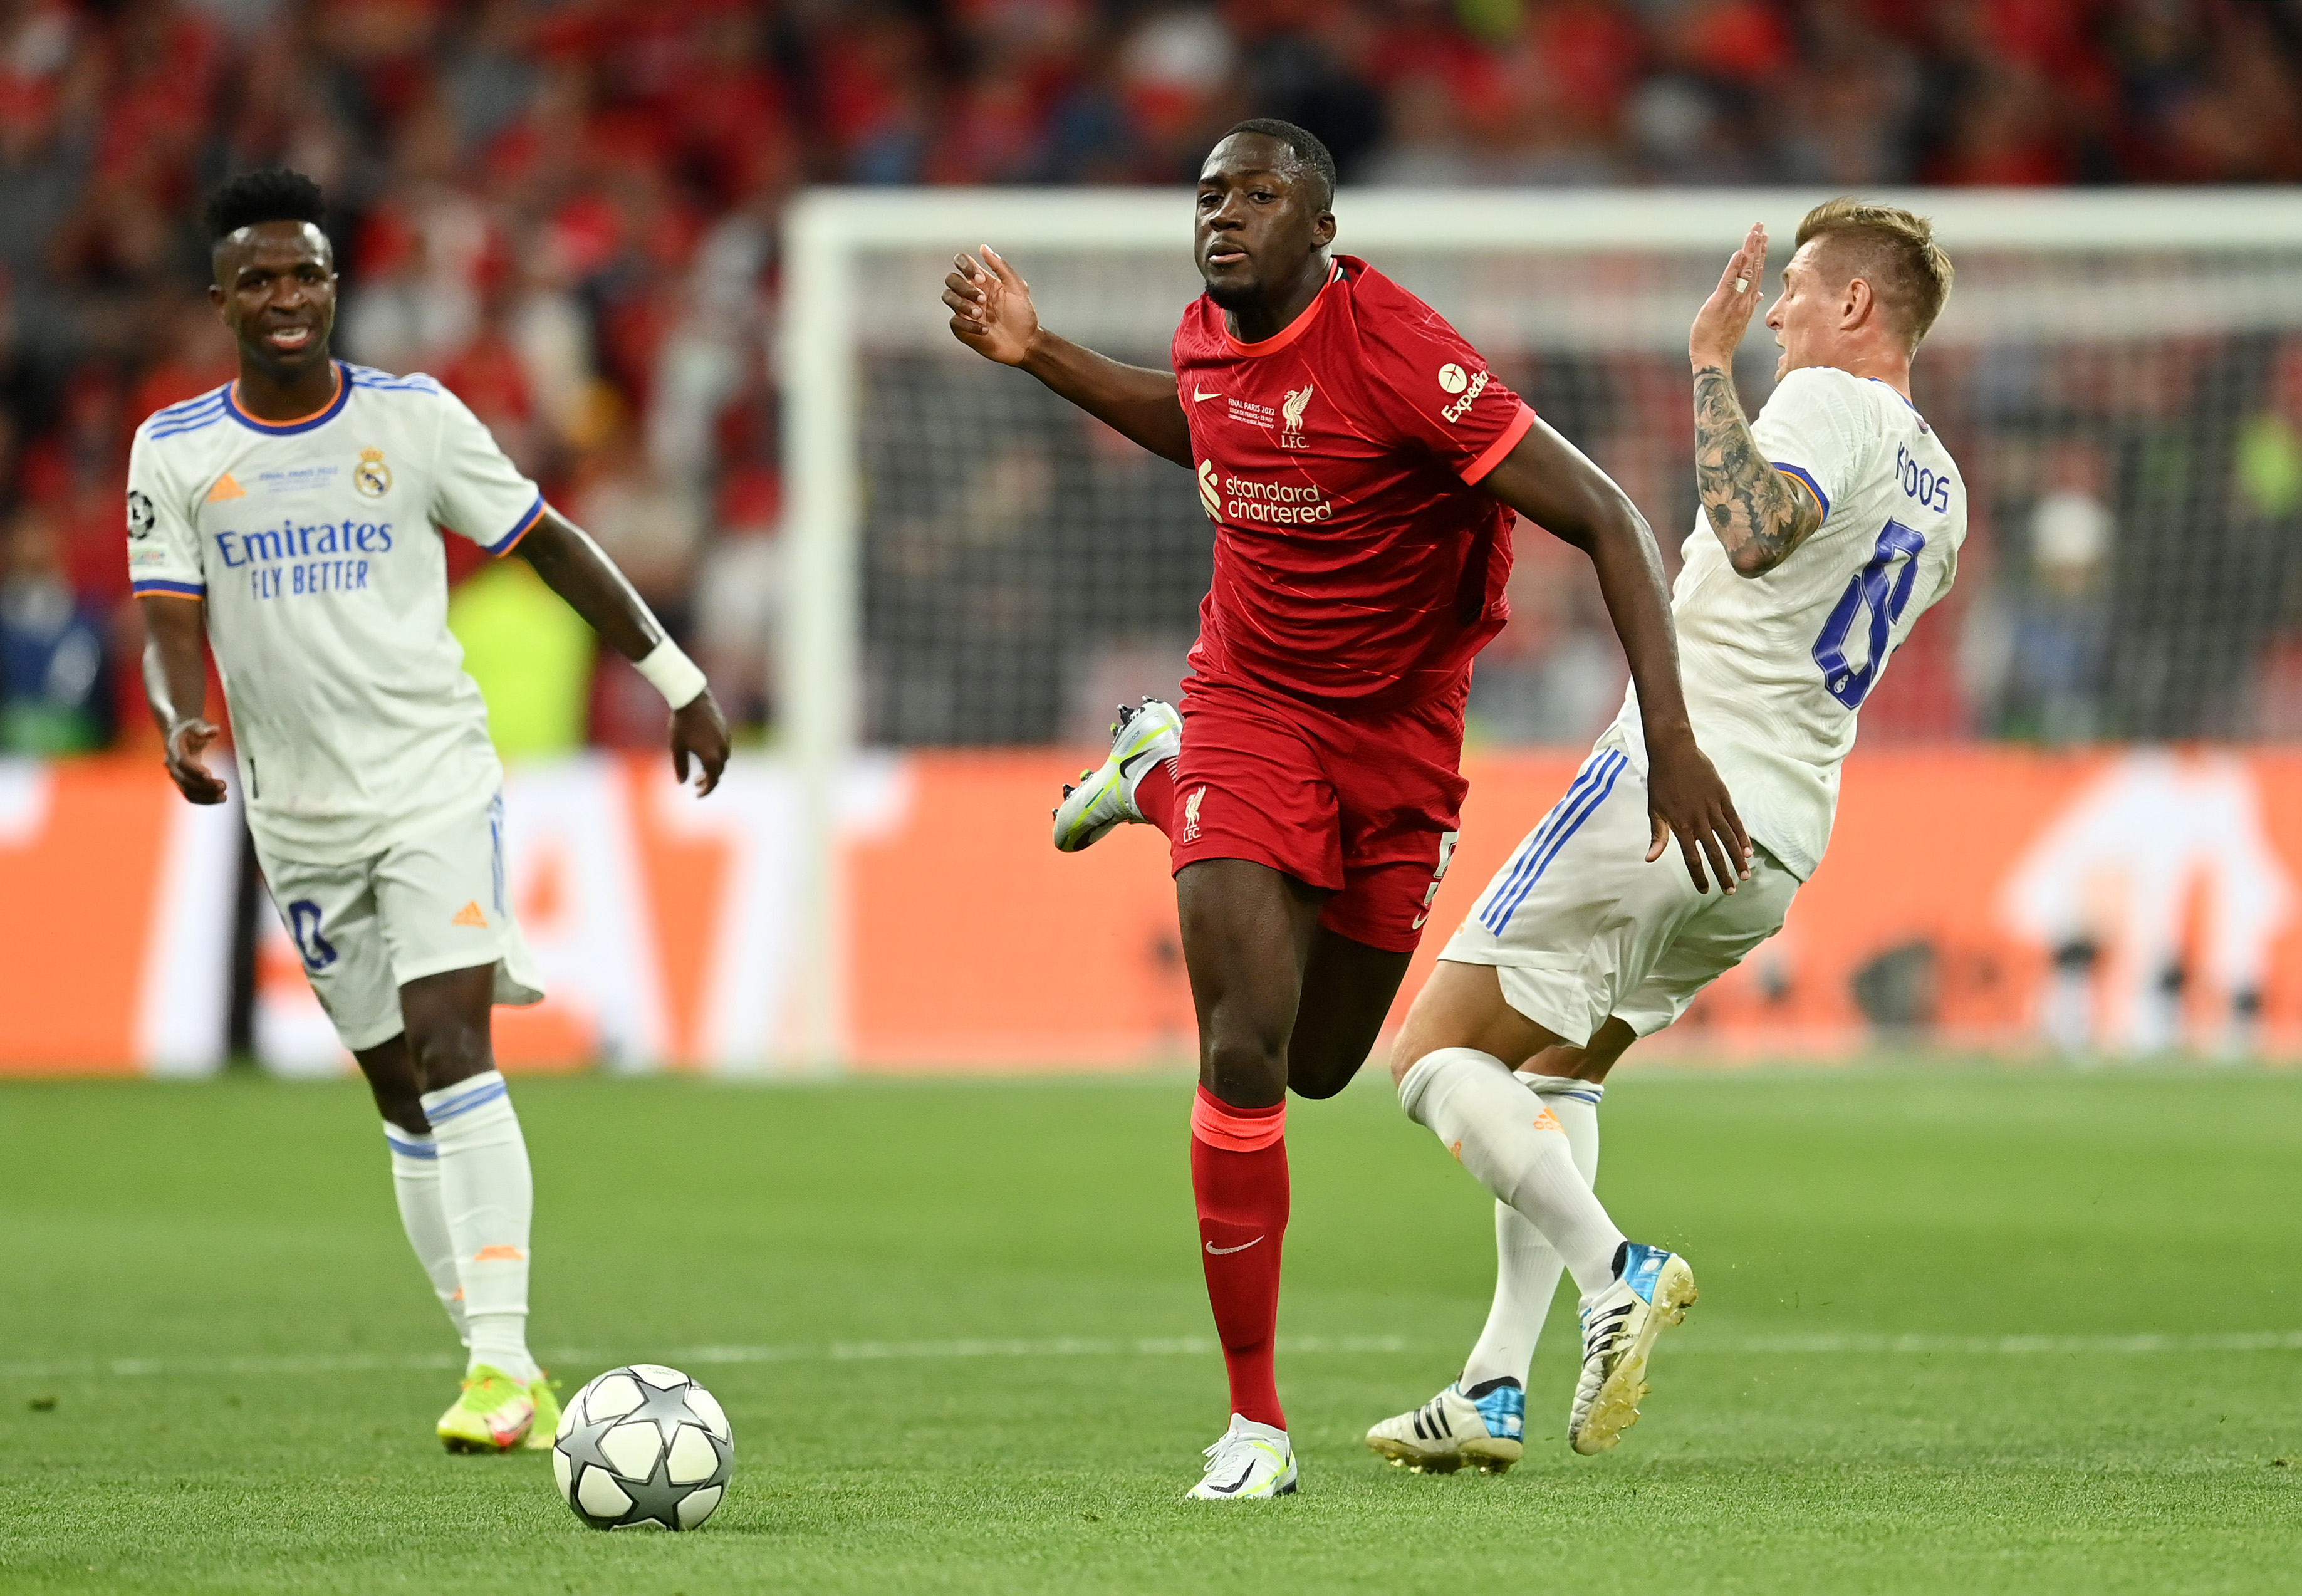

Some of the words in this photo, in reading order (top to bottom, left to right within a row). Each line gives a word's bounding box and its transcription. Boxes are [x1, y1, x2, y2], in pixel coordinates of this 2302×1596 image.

[1228, 398, 1244, 409] FINAL
[1244, 402, 1261, 412] PARIS
[1261, 406, 1275, 416] 2022
[1440, 370, 1489, 423] Expedia
[1226, 475, 1320, 503] standard
[1228, 497, 1333, 523] chartered
[214, 519, 393, 568] Emirates
[251, 567, 282, 600] FLY
[293, 560, 368, 595] BETTER
